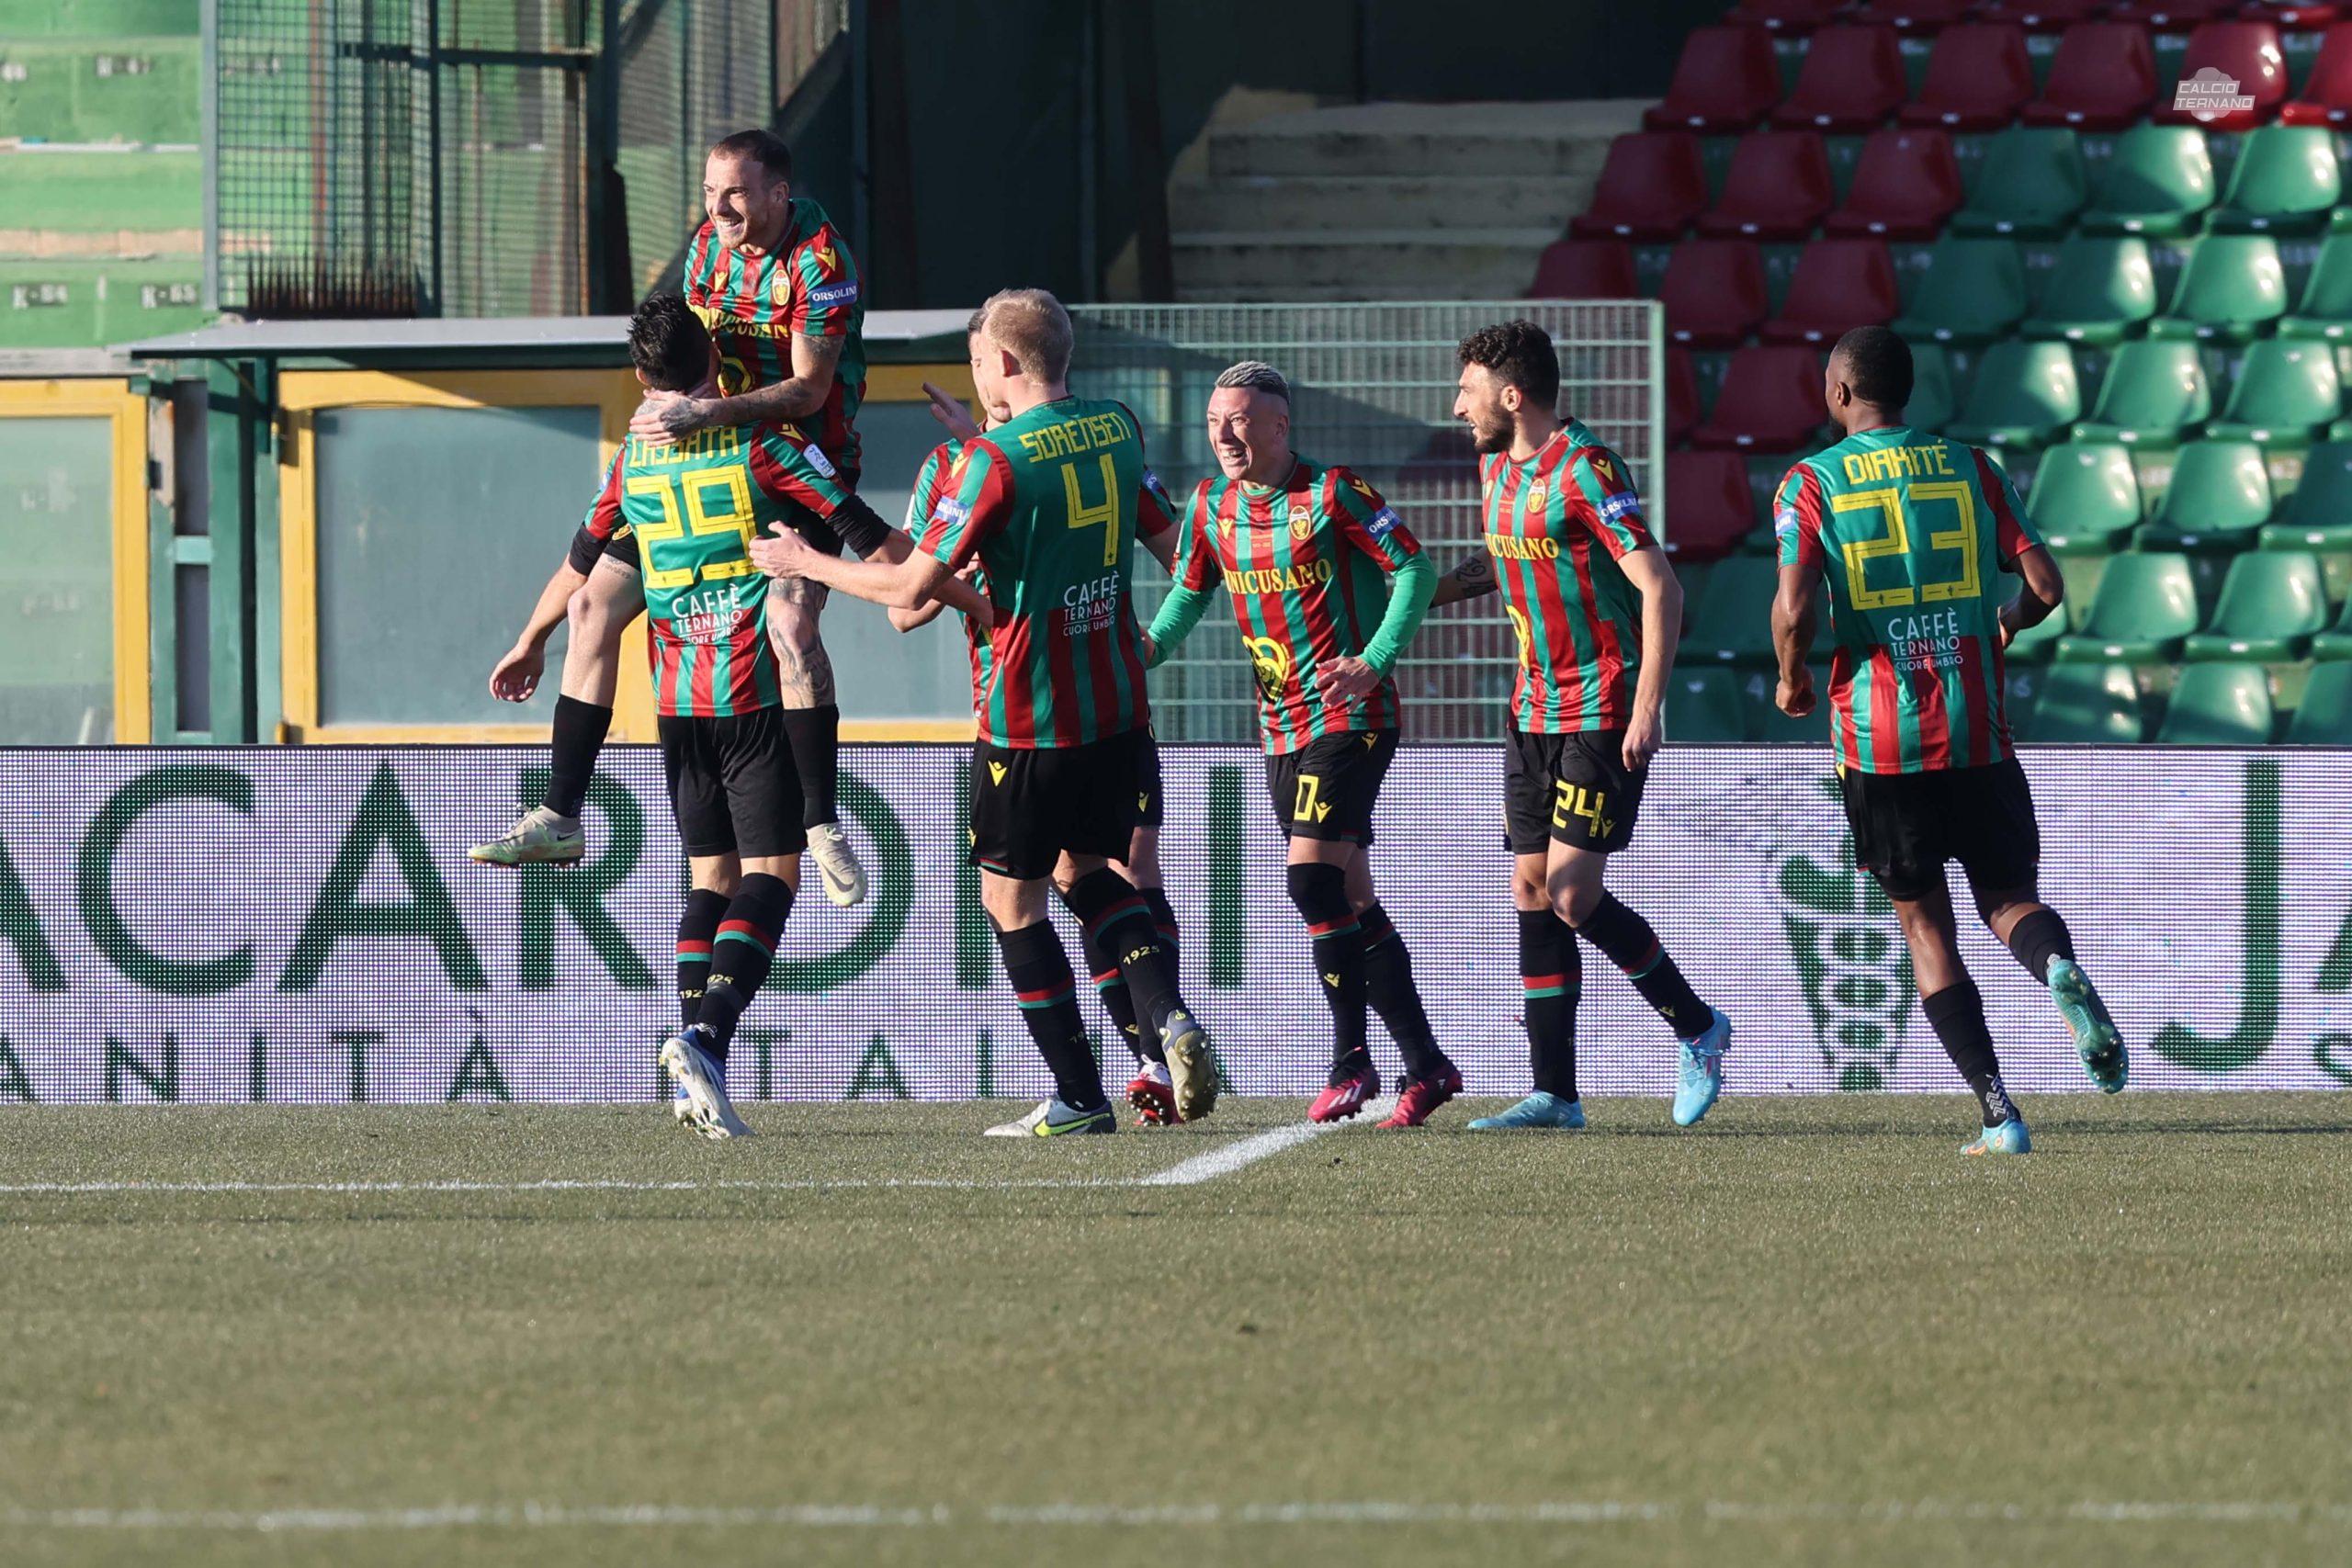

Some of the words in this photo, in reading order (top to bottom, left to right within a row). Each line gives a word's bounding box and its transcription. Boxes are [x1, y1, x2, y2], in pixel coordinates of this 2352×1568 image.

[1018, 412, 1131, 463] SORENSEN
[627, 464, 761, 589] 29
[1061, 453, 1119, 567] 4
[1831, 480, 1982, 610] 23
[672, 582, 742, 618] CAFFÈ
[1063, 570, 1120, 606] CAFFÈ
[675, 609, 743, 634] TERNANO
[1064, 596, 1116, 622] TERNANO
[1887, 607, 1959, 641] CAFFÈ
[1891, 635, 1961, 658] TERNANO
[1553, 779, 1605, 838] 24
